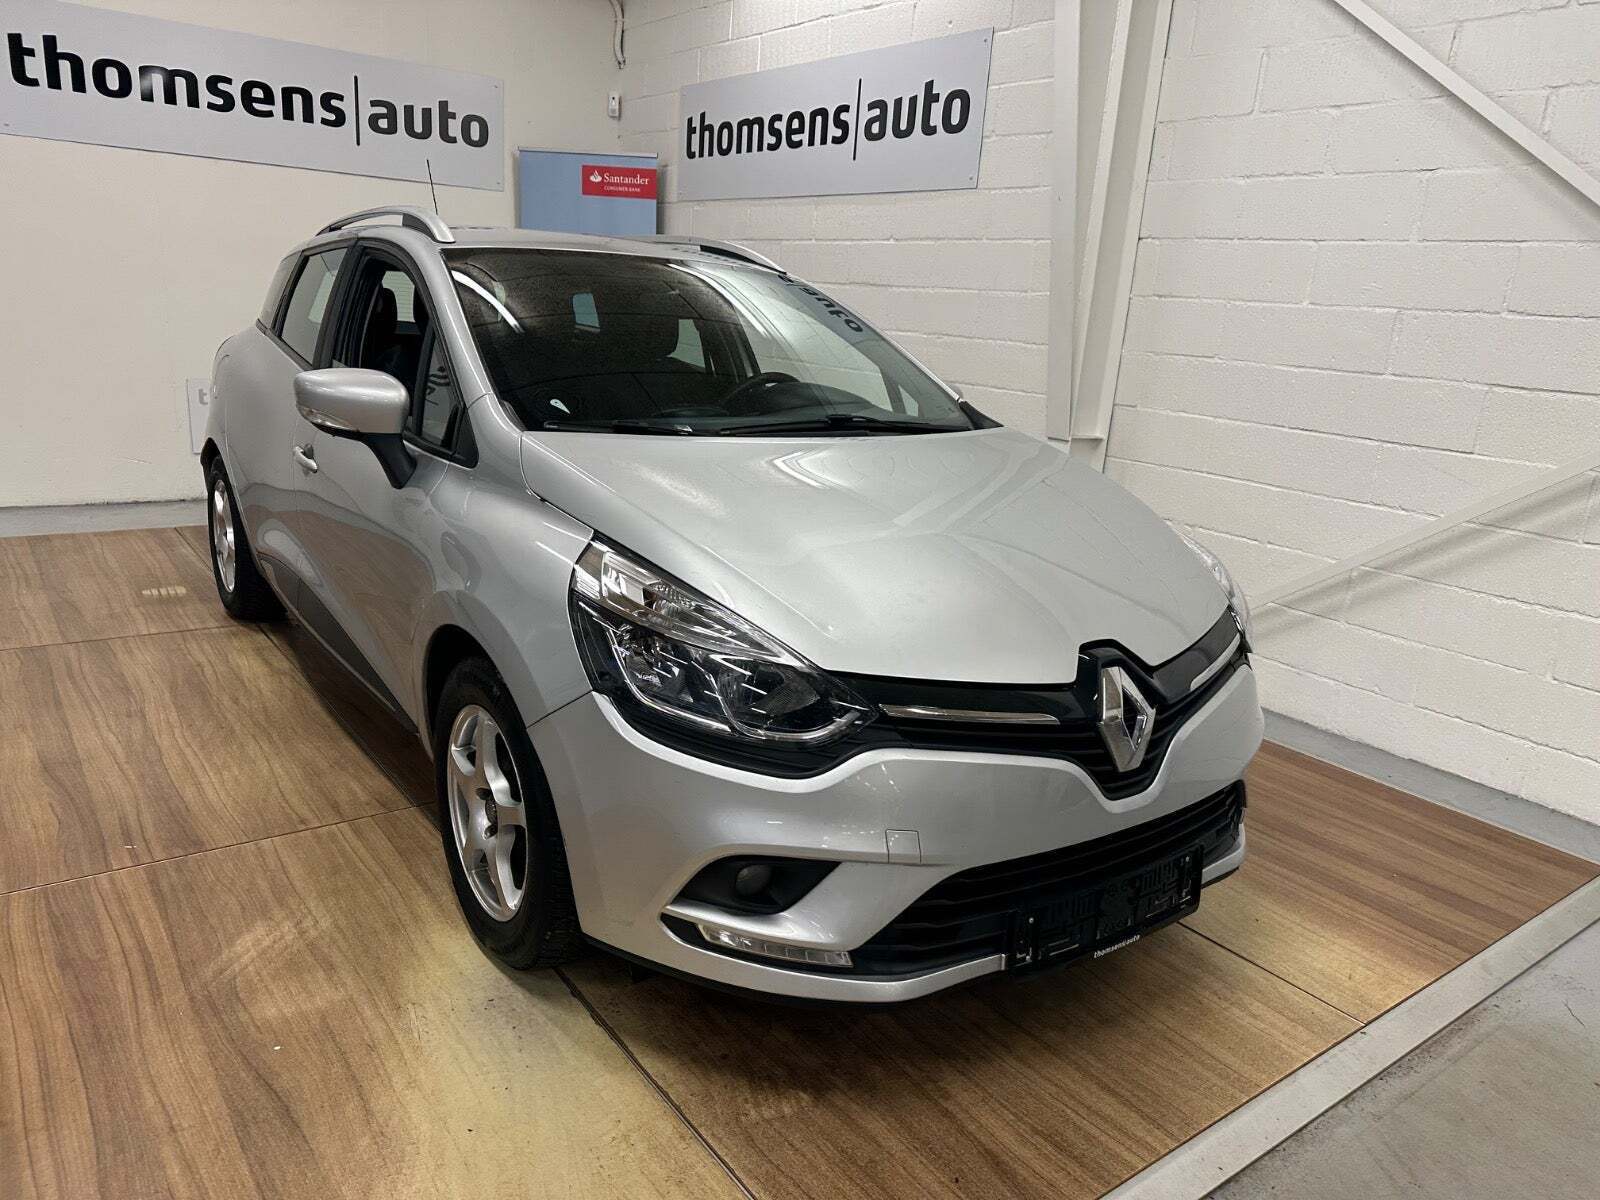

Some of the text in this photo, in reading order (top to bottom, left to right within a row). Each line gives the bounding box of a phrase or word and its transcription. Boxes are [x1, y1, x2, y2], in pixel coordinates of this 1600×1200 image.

[7, 32, 490, 148] thomsens auto
[686, 80, 970, 160] thomsens auto
[603, 173, 649, 184] Santander
